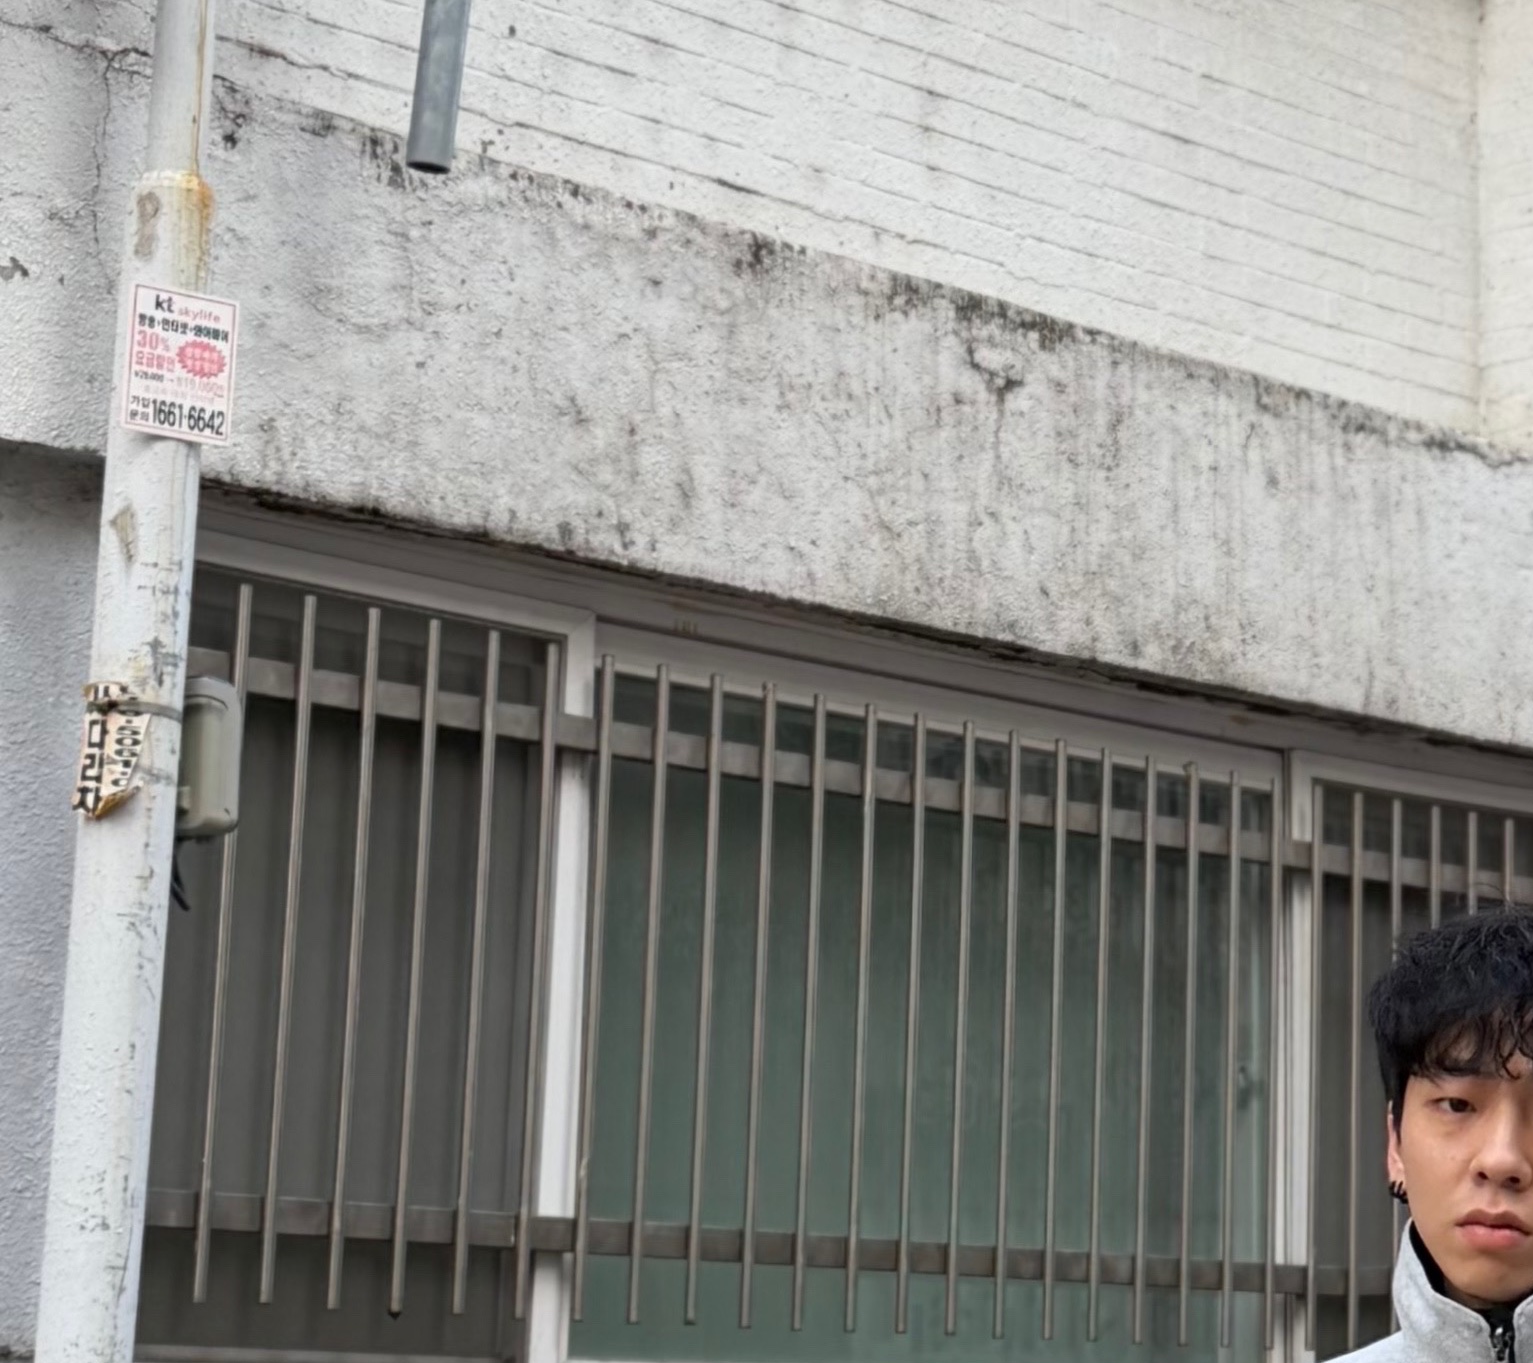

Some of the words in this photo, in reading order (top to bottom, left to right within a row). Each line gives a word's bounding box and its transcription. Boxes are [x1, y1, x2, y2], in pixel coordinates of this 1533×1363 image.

[155, 293, 175, 314] kt
[177, 306, 221, 324] skylife
[137, 329, 170, 352] 30%
[135, 350, 175, 373] 요금할인
[130, 395, 151, 409] 가입
